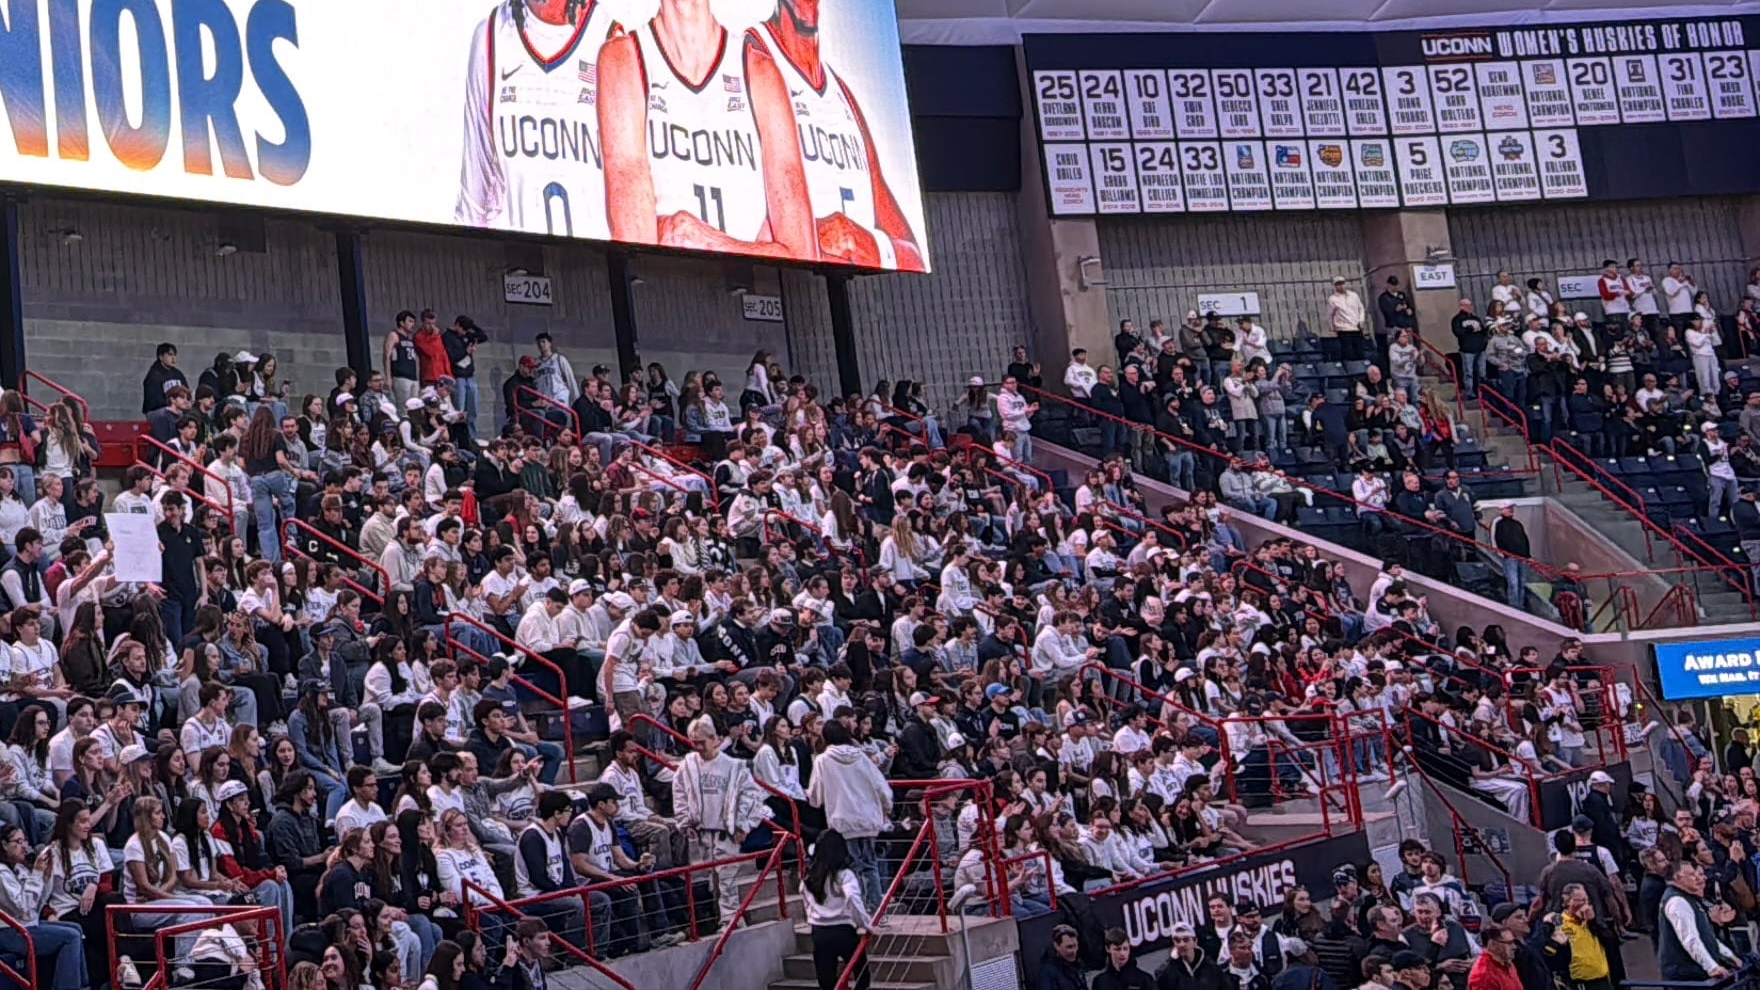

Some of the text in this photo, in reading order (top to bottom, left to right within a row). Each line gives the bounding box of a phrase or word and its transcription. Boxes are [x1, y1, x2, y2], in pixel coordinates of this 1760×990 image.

[1421, 21, 1745, 57] UCONN WOMEN'S HUSKIES OF HONOR
[1572, 61, 1608, 86] 20
[1668, 58, 1695, 82] 31
[1709, 55, 1745, 79] 23
[1039, 75, 1075, 99] 25
[1084, 74, 1119, 99] 24
[1134, 74, 1159, 98] 10
[1173, 73, 1207, 98] 32
[1217, 73, 1251, 97] 50
[1260, 73, 1294, 97] 33
[1306, 72, 1332, 96] 21
[1346, 72, 1378, 96] 42
[1397, 71, 1416, 95] 3
[1434, 68, 1471, 92] 52
[500, 115, 601, 168] UCONN
[651, 119, 756, 170] UCONN
[1548, 134, 1567, 158] 3
[1100, 148, 1126, 172] 15
[1140, 147, 1175, 171] 24
[1184, 146, 1218, 171] 33
[1408, 142, 1427, 166] 5
[693, 184, 726, 232] 11
[1420, 271, 1448, 282] EAST
[1560, 282, 1582, 293] SEC
[506, 281, 550, 300] SEC 204
[759, 300, 781, 317] 205
[1200, 301, 1221, 310] SEC
[308, 540, 318, 553] C
[1684, 653, 1752, 671] AWARD
[1122, 881, 1206, 947] UCONN
